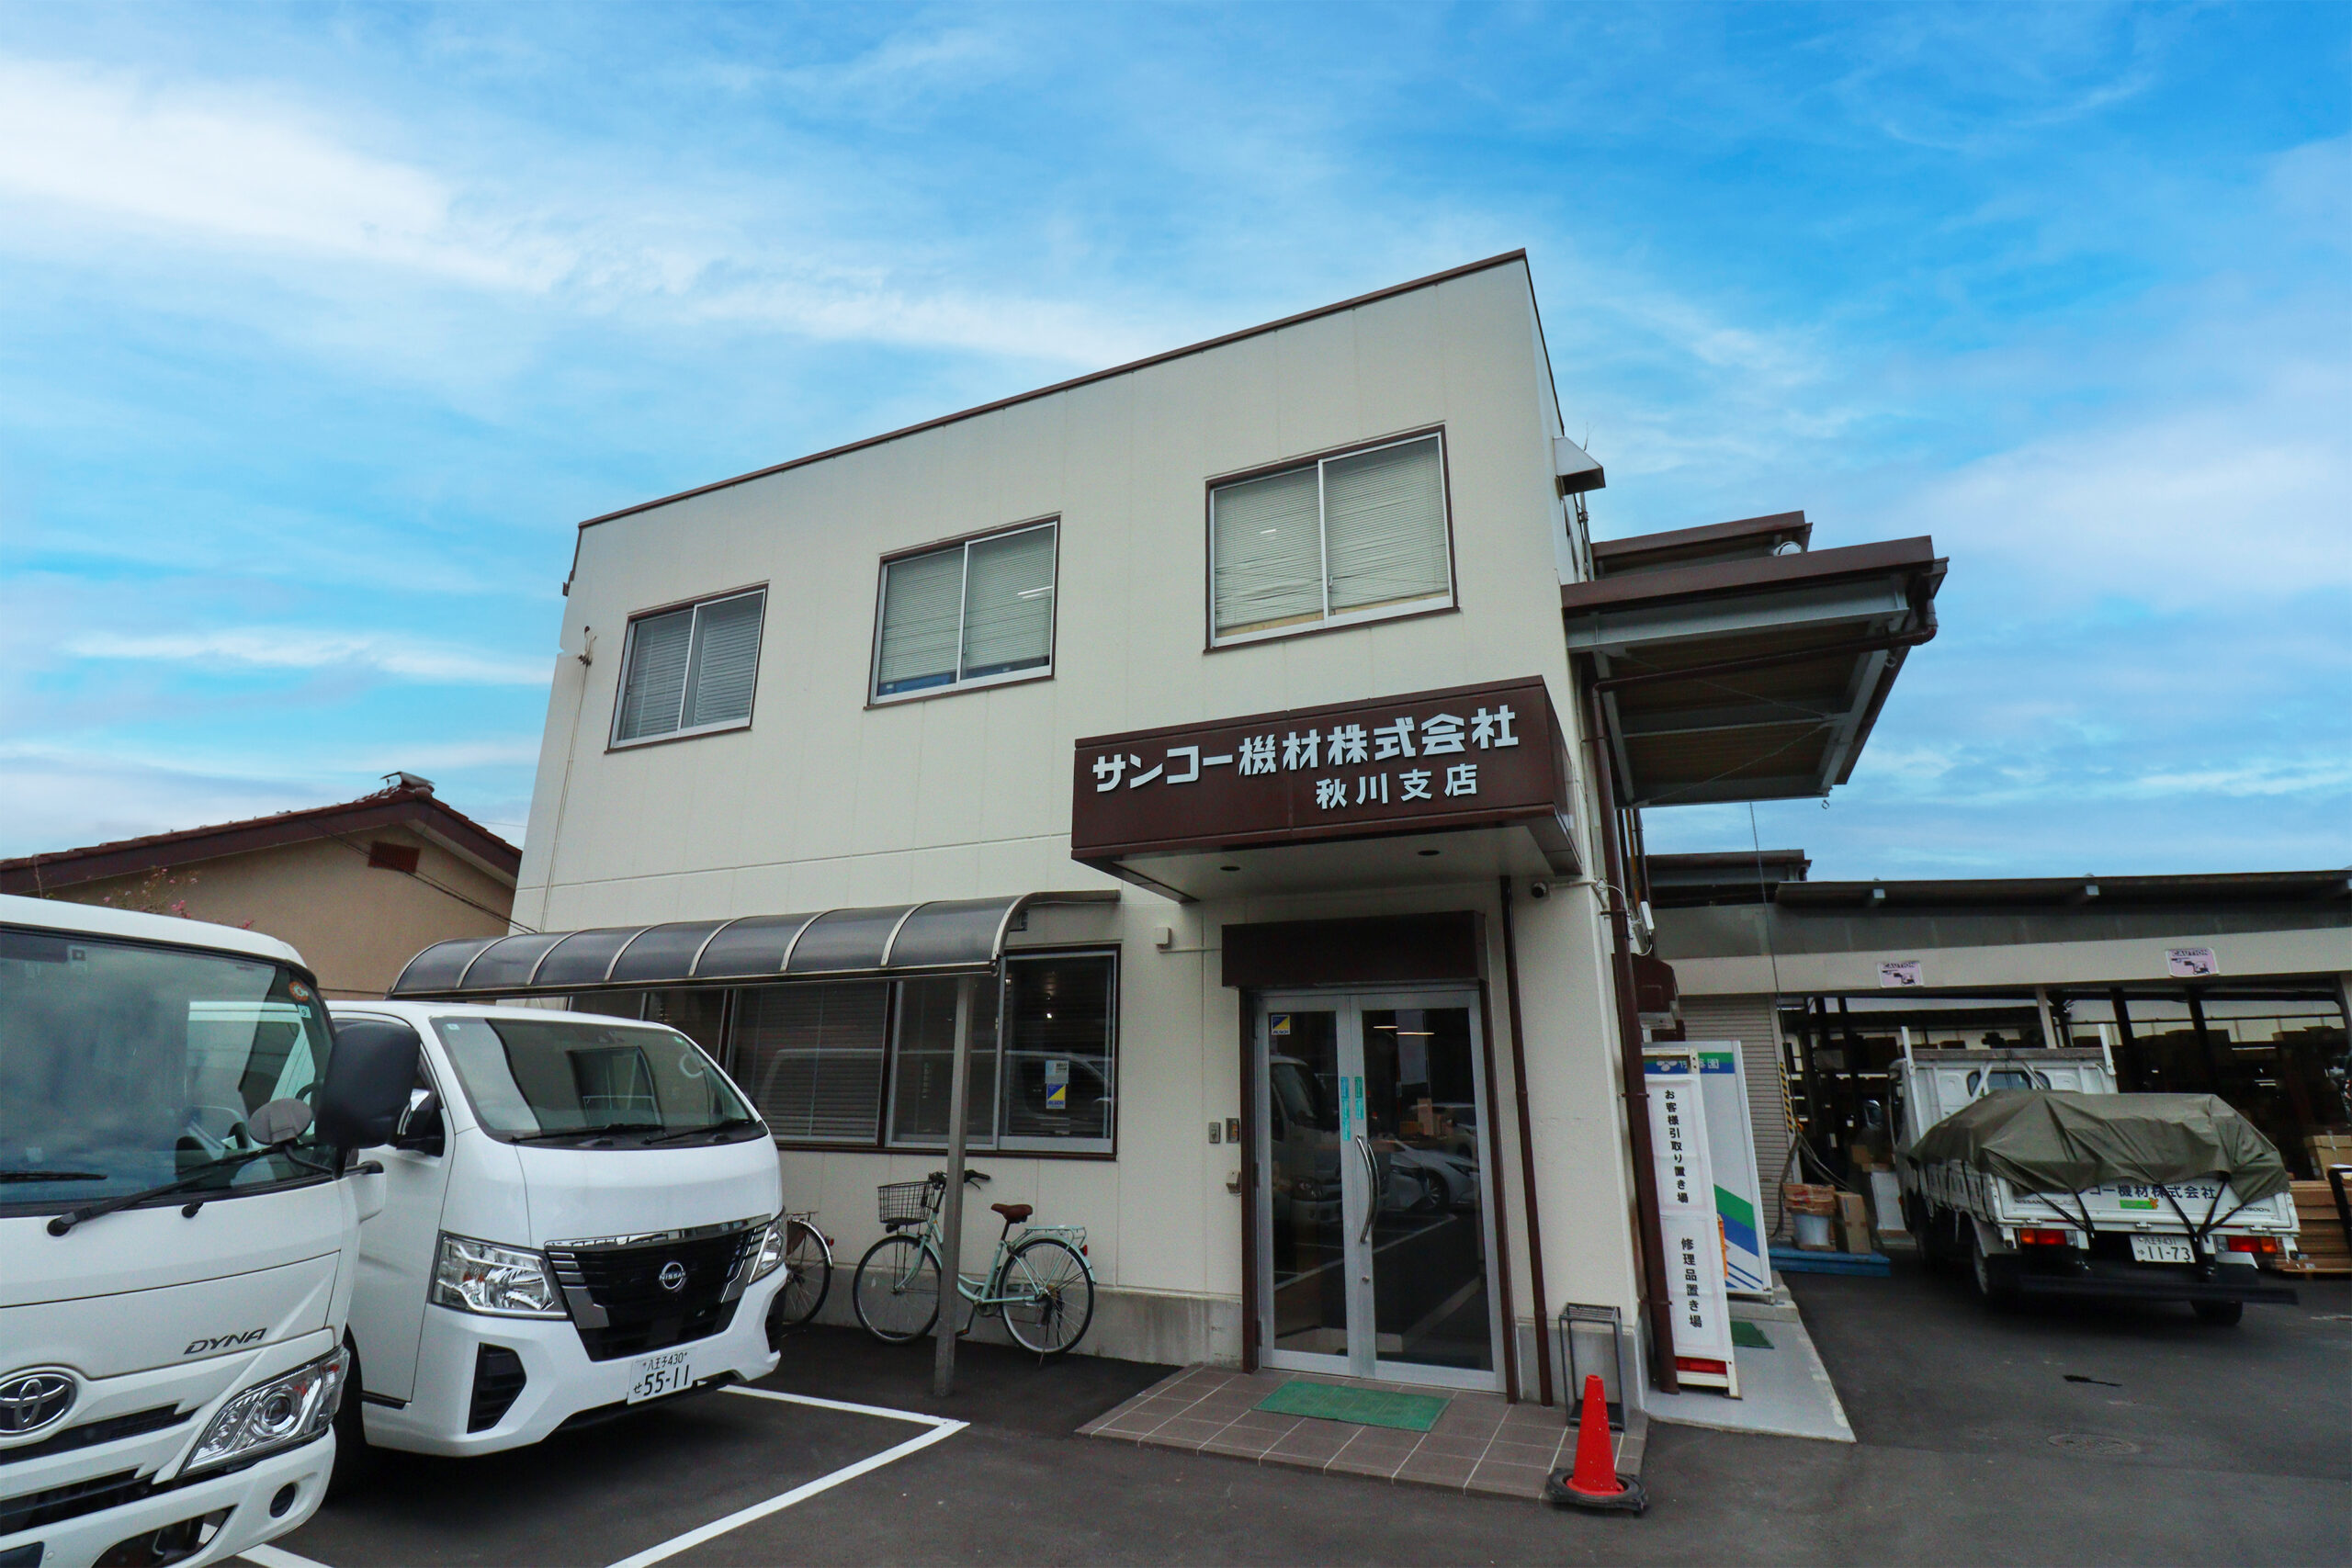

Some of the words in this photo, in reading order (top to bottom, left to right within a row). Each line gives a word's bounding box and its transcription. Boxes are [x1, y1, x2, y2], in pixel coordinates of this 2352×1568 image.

[1092, 705, 1519, 792] サンコー機材株式会社
[1316, 763, 1478, 809] 秋川支店
[1665, 1089, 1689, 1204] お客様引取り置き場
[2147, 1246, 2191, 1260] 11-73
[1681, 1237, 1702, 1328] 修理品置き場
[184, 1326, 267, 1355] DYNA
[643, 1364, 690, 1396] 55-11
[646, 1351, 684, 1372] 八王子430
